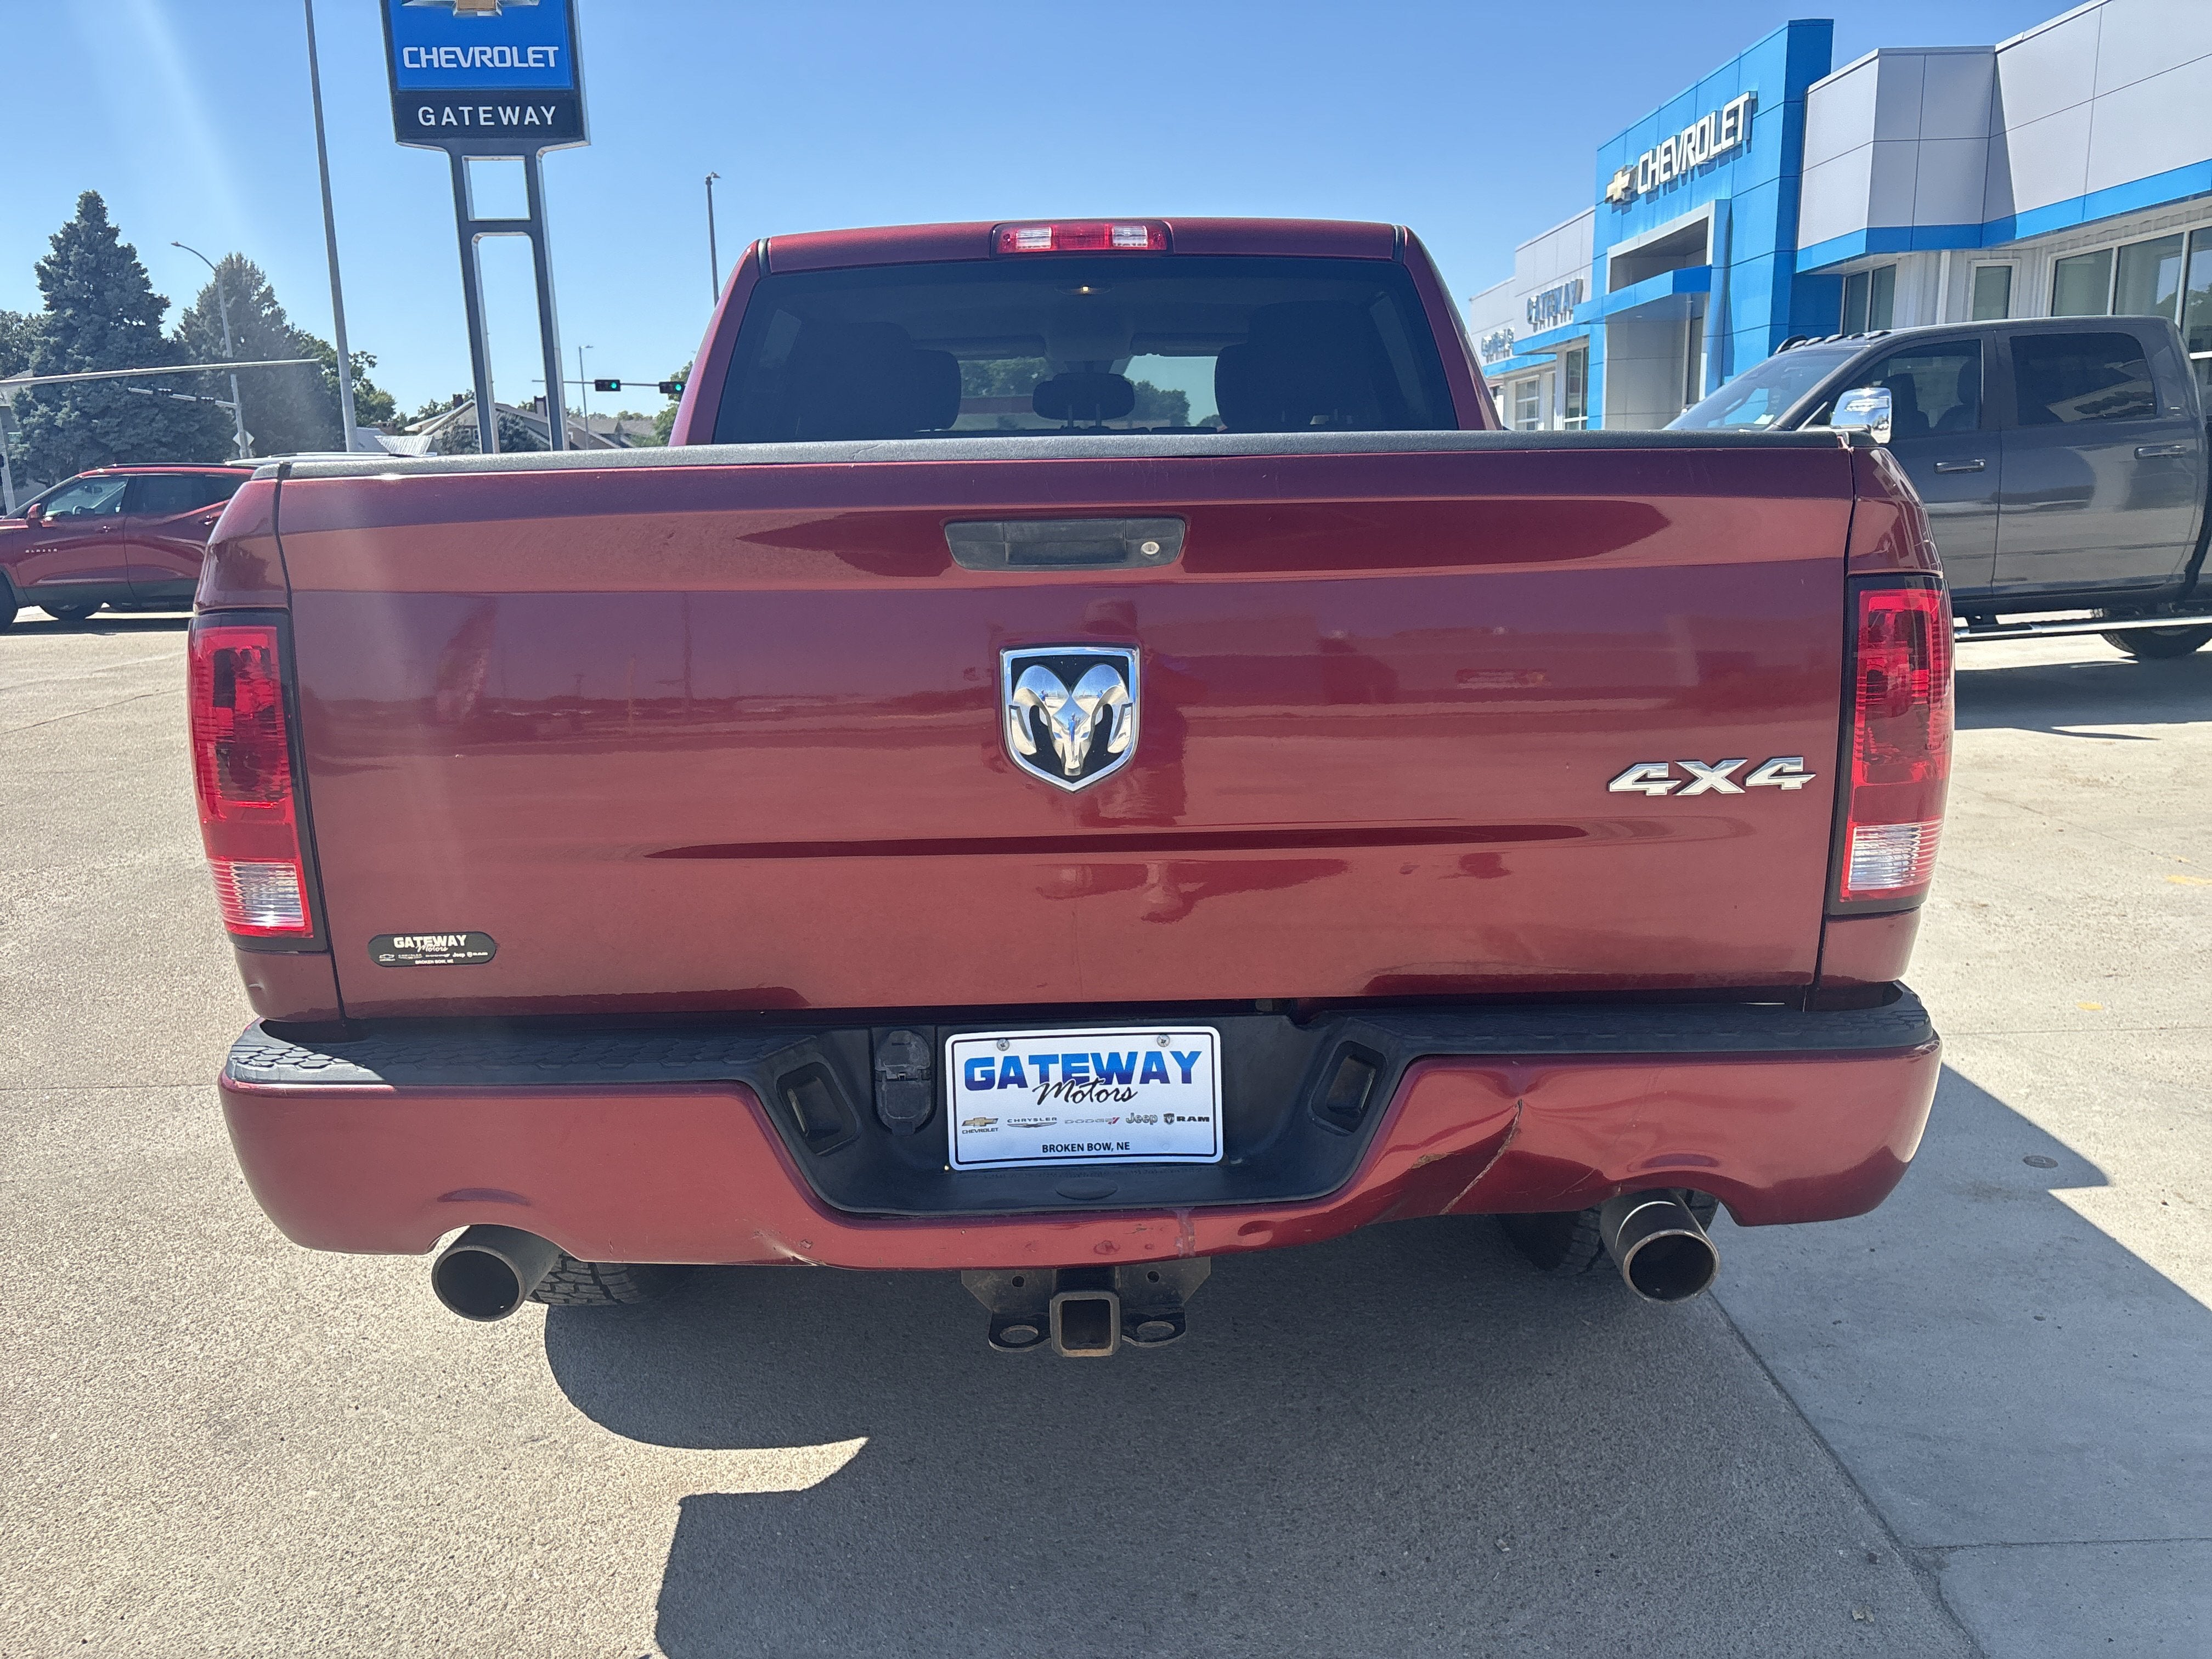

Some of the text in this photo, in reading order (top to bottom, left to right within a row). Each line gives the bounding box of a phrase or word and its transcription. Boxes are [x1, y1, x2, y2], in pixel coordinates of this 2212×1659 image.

[403, 46, 559, 68] CHEVROLET
[417, 105, 556, 126] GATEWAY
[1637, 91, 1754, 195] CHEVROLET
[393, 934, 467, 949] GATEWAY
[416, 944, 449, 952] Motors
[964, 1051, 1203, 1091] GATEWAY
[1032, 1076, 1139, 1105] Motors
[1125, 1112, 1159, 1125] Jeep
[1042, 1142, 1130, 1153] BROKEN BOW, NE
